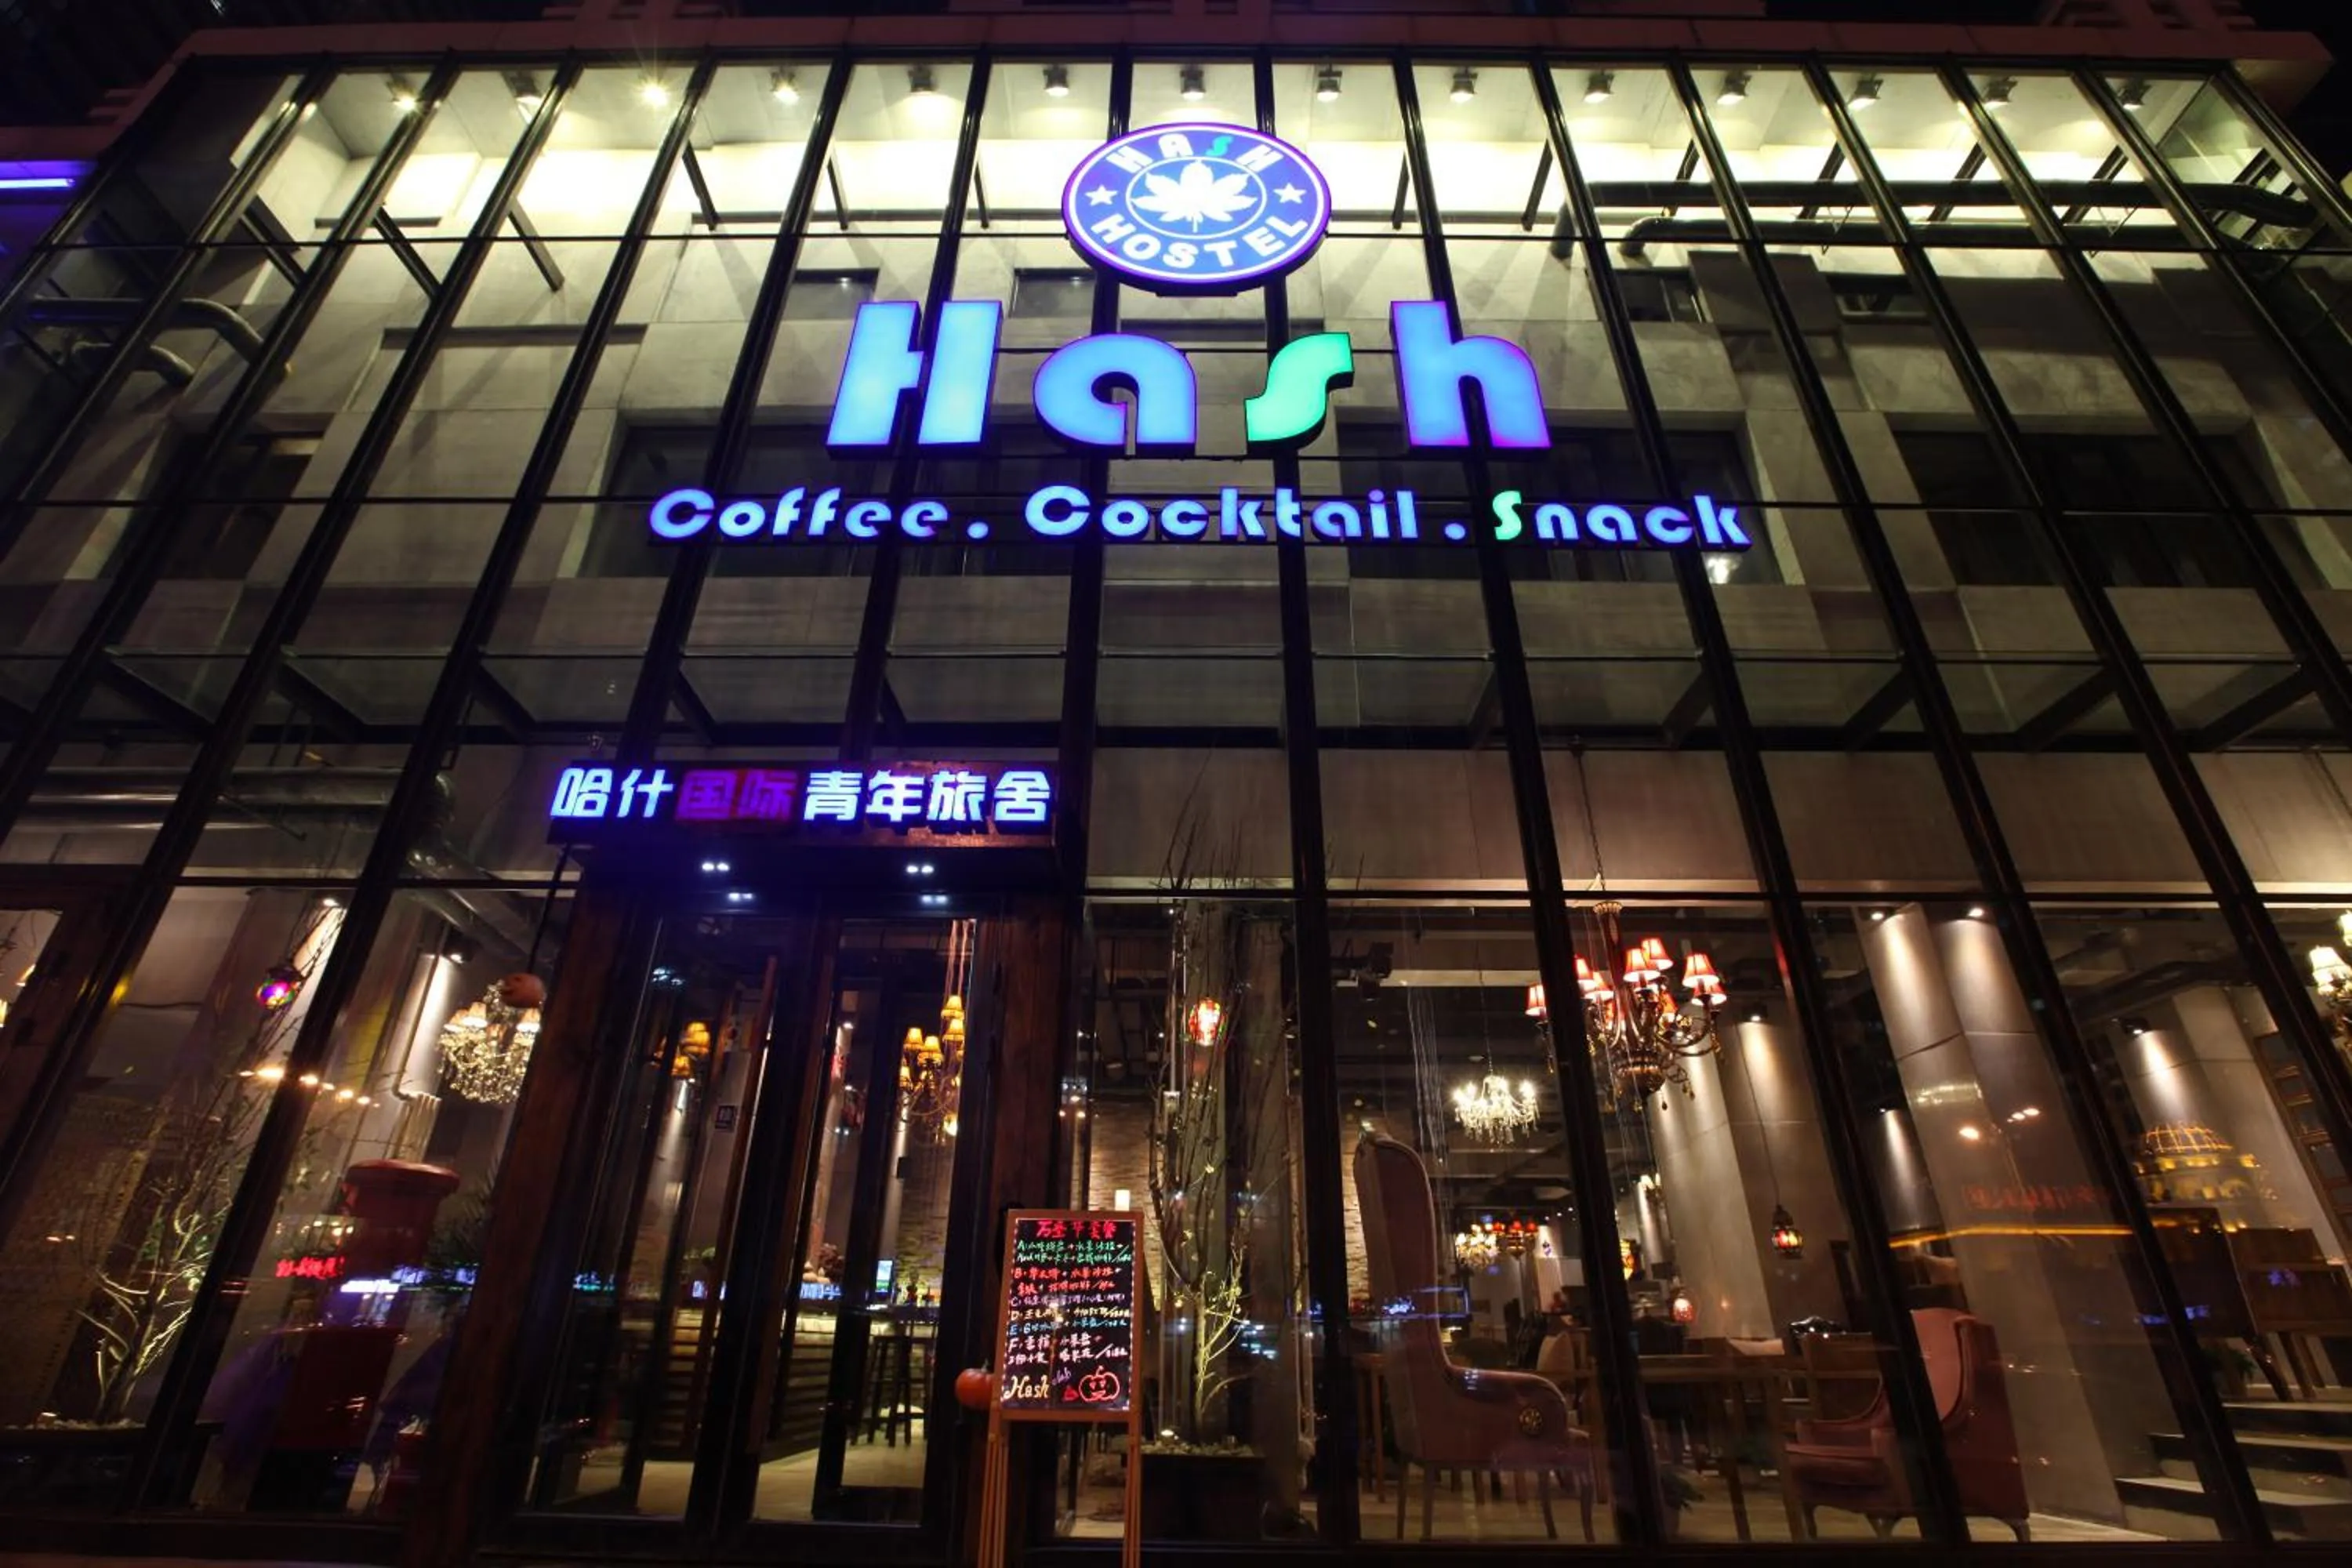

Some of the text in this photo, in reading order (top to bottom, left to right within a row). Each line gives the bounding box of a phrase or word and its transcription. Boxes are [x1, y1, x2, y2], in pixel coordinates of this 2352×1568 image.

[1106, 132, 1284, 174] HASH
[1091, 213, 1309, 269] HOSTEL
[826, 299, 1551, 449] Hash
[1493, 489, 1753, 547] Snack
[550, 768, 1051, 823] 哈什国际青年旅舍
[1003, 1374, 1050, 1400] Hash
